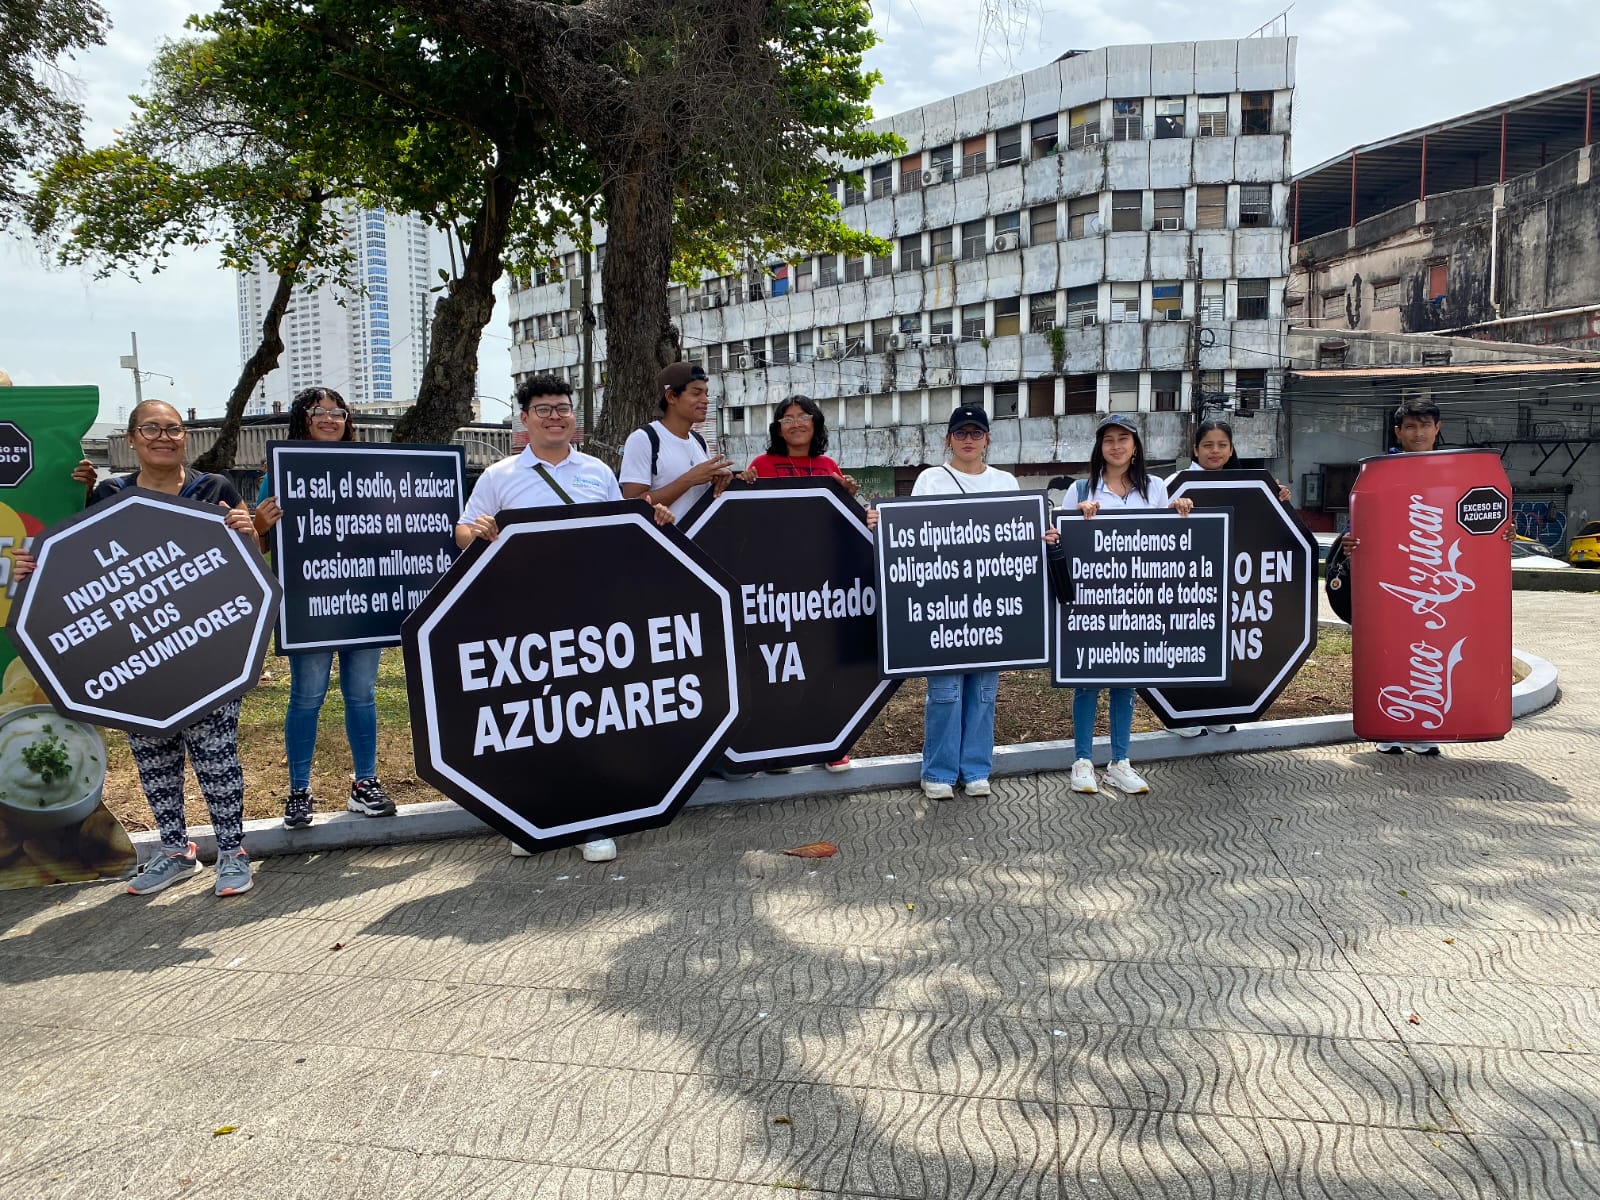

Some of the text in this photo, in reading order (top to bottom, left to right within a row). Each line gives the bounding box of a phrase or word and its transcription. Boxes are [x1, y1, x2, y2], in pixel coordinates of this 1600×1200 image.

[287, 471, 455, 504] La sal, el sodio, el azúcar
[1463, 502, 1503, 512] EXCESO EN
[1464, 511, 1501, 521] AZÚCARES
[297, 509, 453, 543] y las grasas en exceso,
[889, 518, 1035, 551] Los diputados están
[1094, 529, 1192, 552] Defendemos el
[93, 539, 129, 569] LA
[302, 548, 452, 580] ocasionan millones de
[1072, 555, 1213, 579] Derecho Humano a la
[1261, 551, 1293, 583] EN
[62, 540, 186, 615] INDUSTRIA
[889, 554, 1038, 587] obligados a proteger
[48, 546, 228, 655] DEBE PROTEGER
[309, 585, 431, 617] muertes en el mu
[741, 578, 875, 632] Etiquetado
[908, 593, 1023, 622] la salud de sus
[1066, 581, 1217, 605] limentación de todos:
[129, 606, 181, 644] A LOS
[1068, 608, 1215, 635] áreas urbanas, rurales
[1377, 494, 1476, 730] Buco Azúcar
[84, 595, 253, 700] CONSUMIDORES
[458, 612, 703, 692] EXCESO EN
[930, 623, 1003, 649] electores
[760, 641, 806, 684] YA
[1077, 641, 1206, 670] y pueblos indígenas
[473, 674, 703, 757] AZÚCARES
